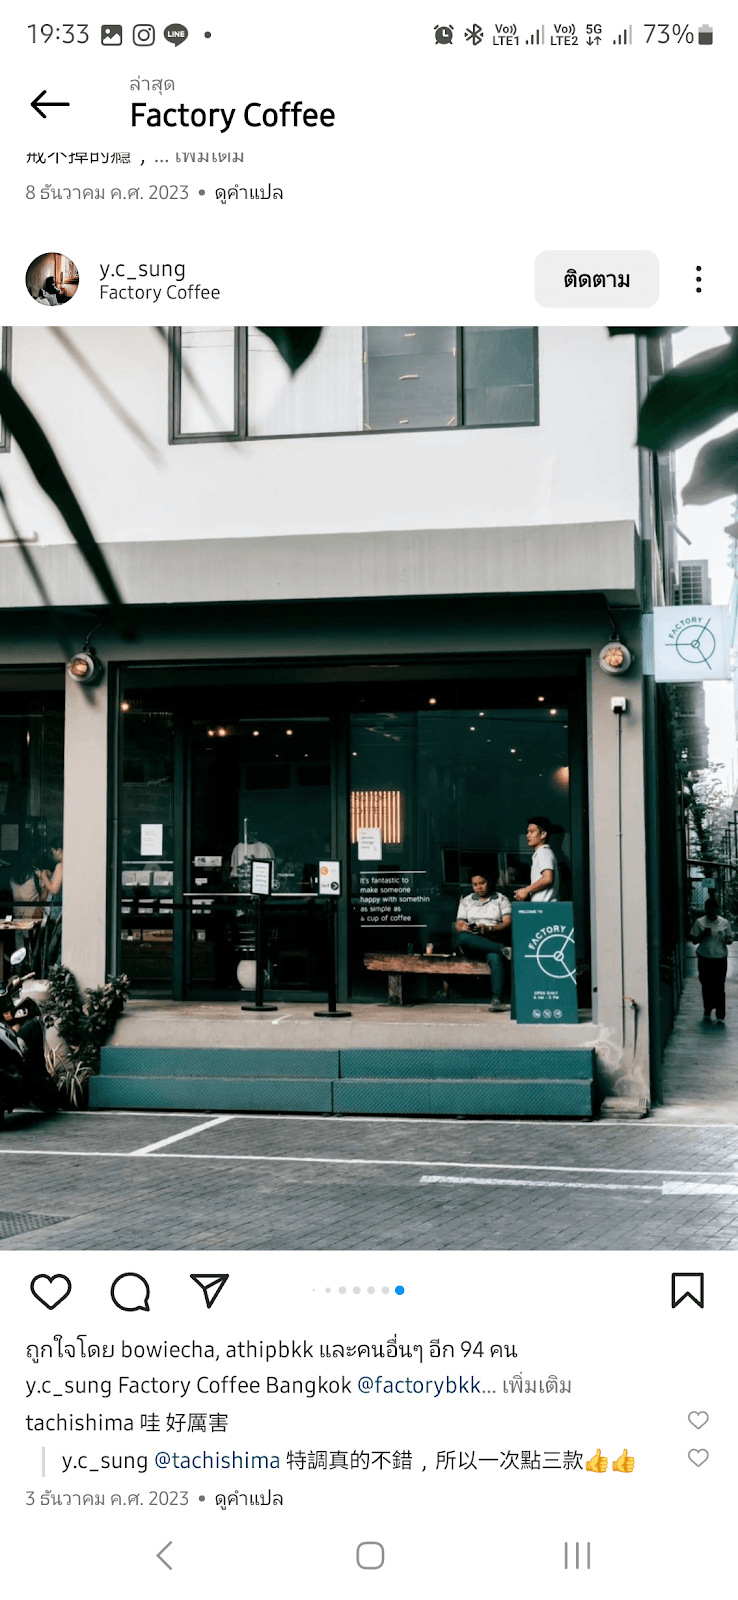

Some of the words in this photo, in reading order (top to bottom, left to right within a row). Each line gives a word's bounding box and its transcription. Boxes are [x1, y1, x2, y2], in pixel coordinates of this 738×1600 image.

[668, 616, 703, 639] FACTORY
[360, 876, 370, 884] It's
[371, 876, 400, 884] fantastic
[360, 886, 379, 894] make
[360, 896, 381, 905] happy
[369, 905, 392, 913] simple
[366, 915, 379, 923] cup
[380, 914, 389, 922] of
[389, 914, 412, 922] coffee
[528, 924, 567, 950] FACTORY
